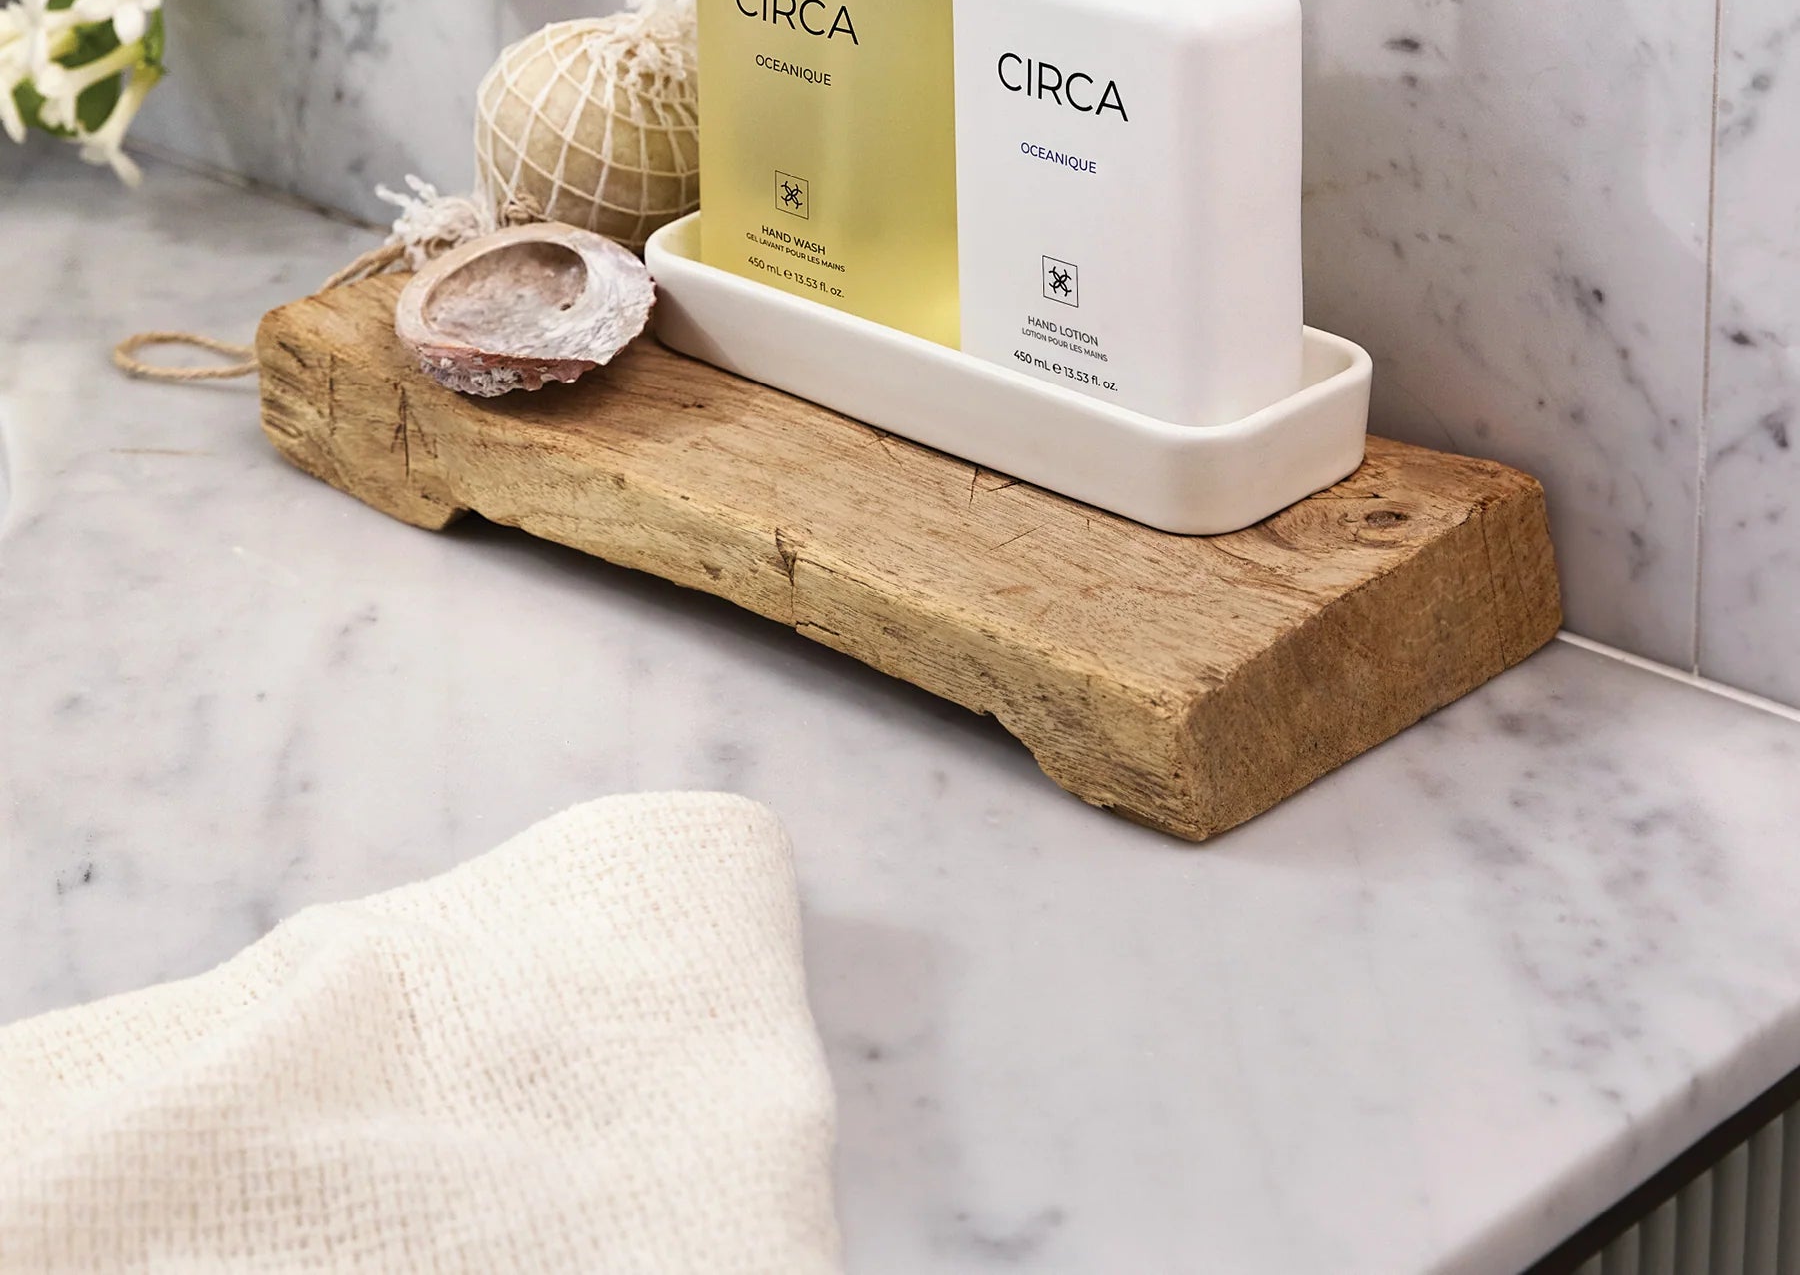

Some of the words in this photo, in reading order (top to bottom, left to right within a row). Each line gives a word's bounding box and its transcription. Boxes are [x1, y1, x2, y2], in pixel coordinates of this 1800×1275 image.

[755, 54, 832, 86] OCEANIQUE
[998, 52, 1129, 122] CIRCA
[1020, 142, 1097, 174] OCEANIQUE
[746, 232, 759, 243] GEL
[759, 237, 785, 252] LAVANT
[785, 247, 806, 260] POUR
[807, 255, 821, 265] LES
[821, 260, 846, 273] MAINS
[761, 225, 792, 243] HAND
[793, 236, 826, 255] WASH
[748, 256, 765, 270] 450
[766, 264, 782, 277] mL
[794, 272, 818, 289] 13.53
[830, 287, 845, 298] oz.
[1021, 327, 1047, 342] LOTION
[1048, 336, 1069, 349] POUR
[1069, 343, 1083, 354] LES
[1083, 348, 1109, 362] MAINS
[1027, 315, 1057, 333] HAND
[1059, 325, 1099, 346] LOTION
[1013, 349, 1032, 364] 450
[1034, 358, 1051, 371] mL
[1063, 366, 1089, 384] 13.53
[1103, 381, 1118, 391] oz.
